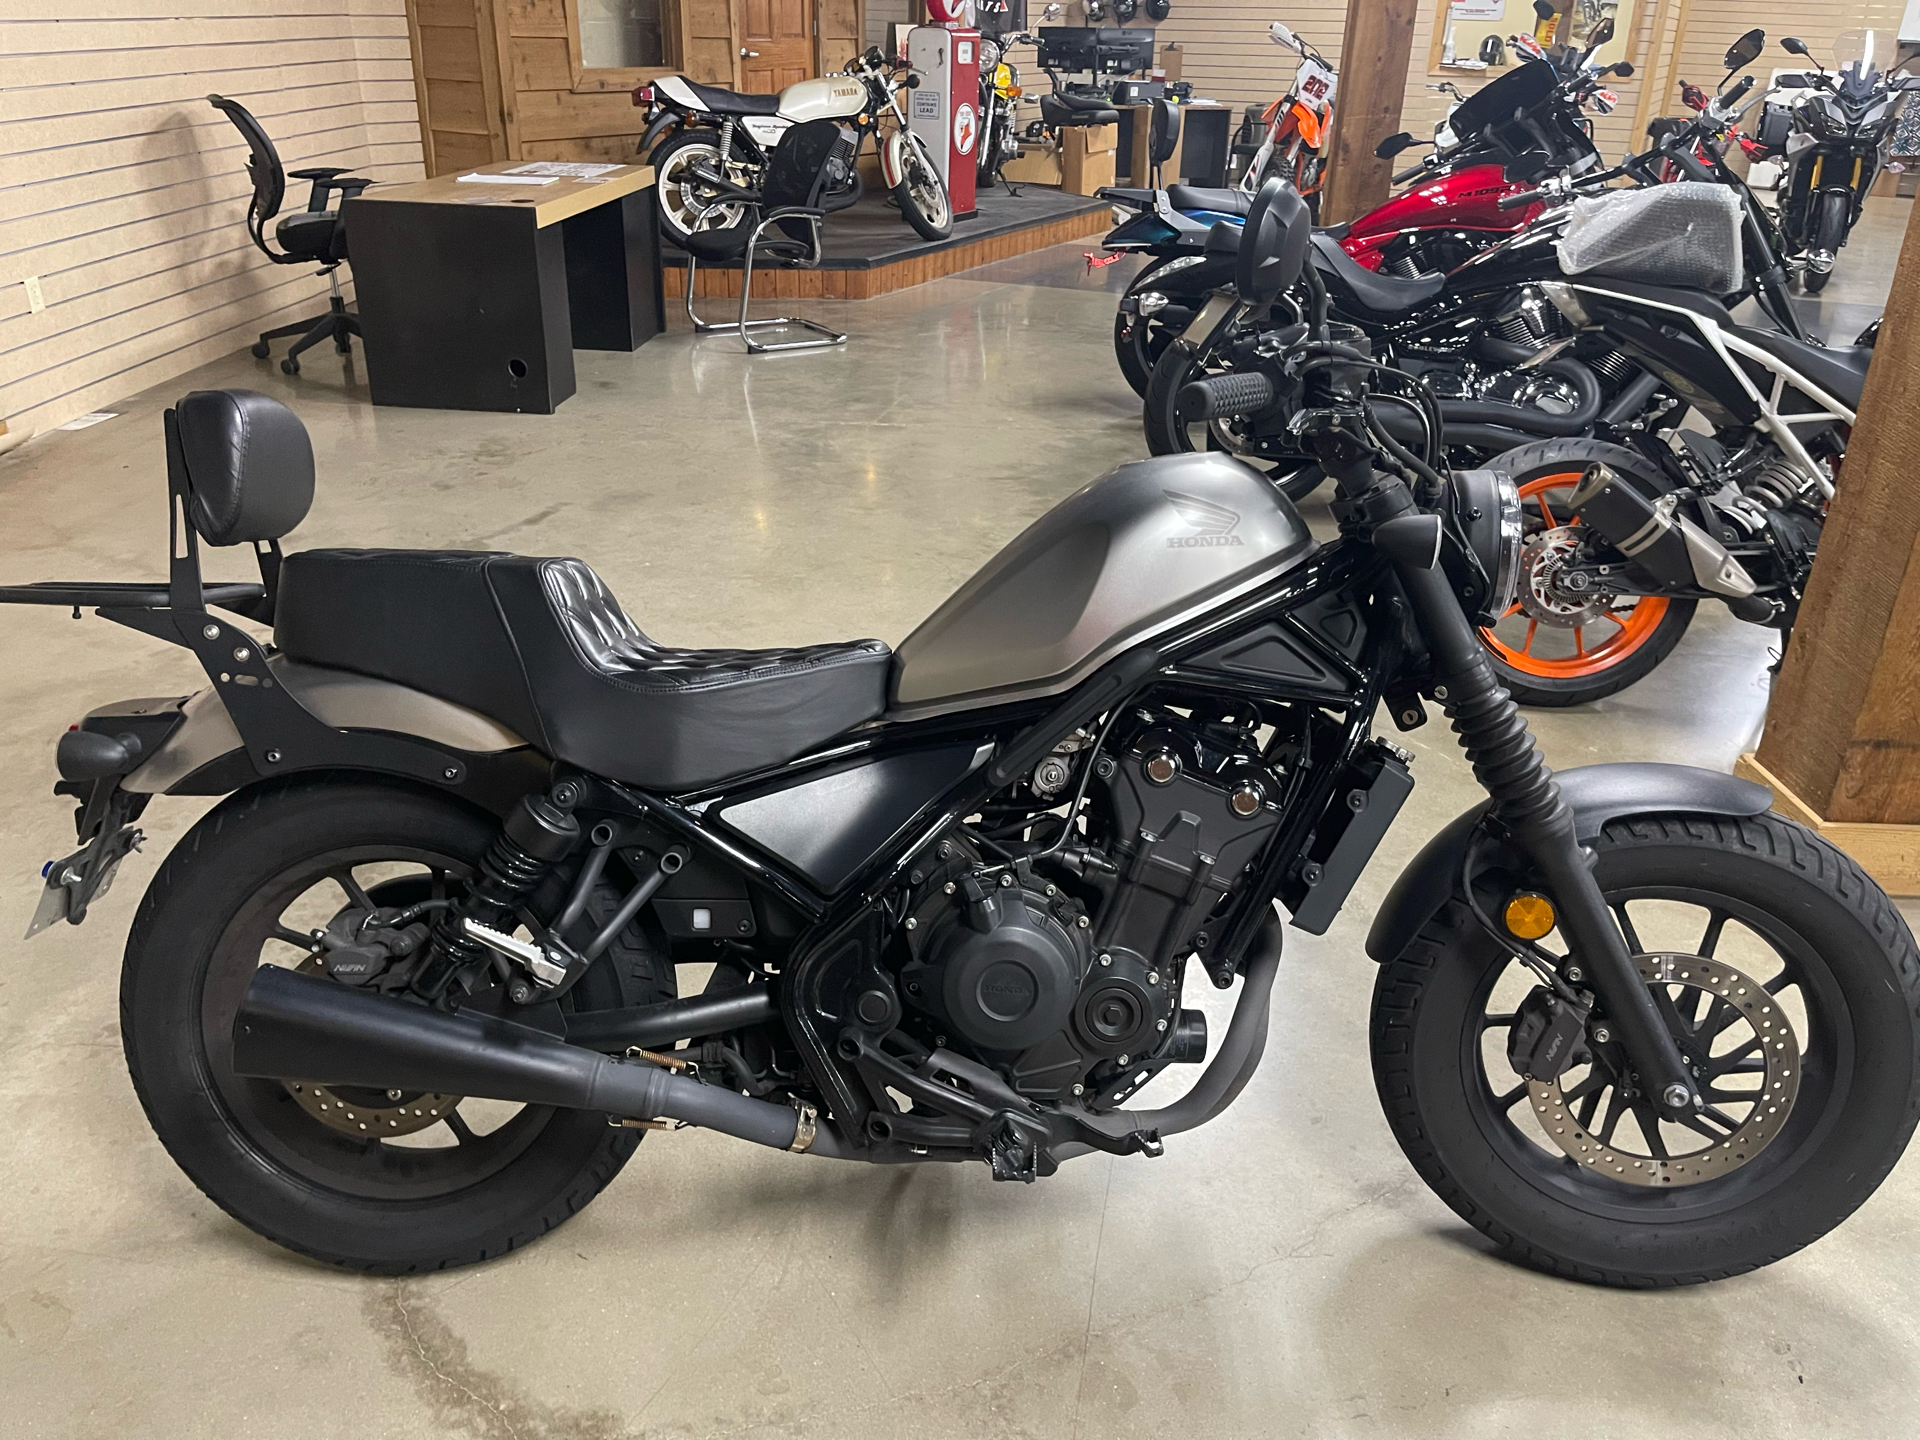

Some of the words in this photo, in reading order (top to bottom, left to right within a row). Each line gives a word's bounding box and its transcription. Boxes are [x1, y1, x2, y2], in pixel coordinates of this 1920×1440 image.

[1544, 17, 1559, 42] SOLD
[1519, 34, 1541, 54] KTM
[833, 88, 858, 97] YAMAHA
[1301, 74, 1330, 101] 202
[1166, 535, 1245, 548] HONDA
[983, 985, 1031, 996] HONDA
